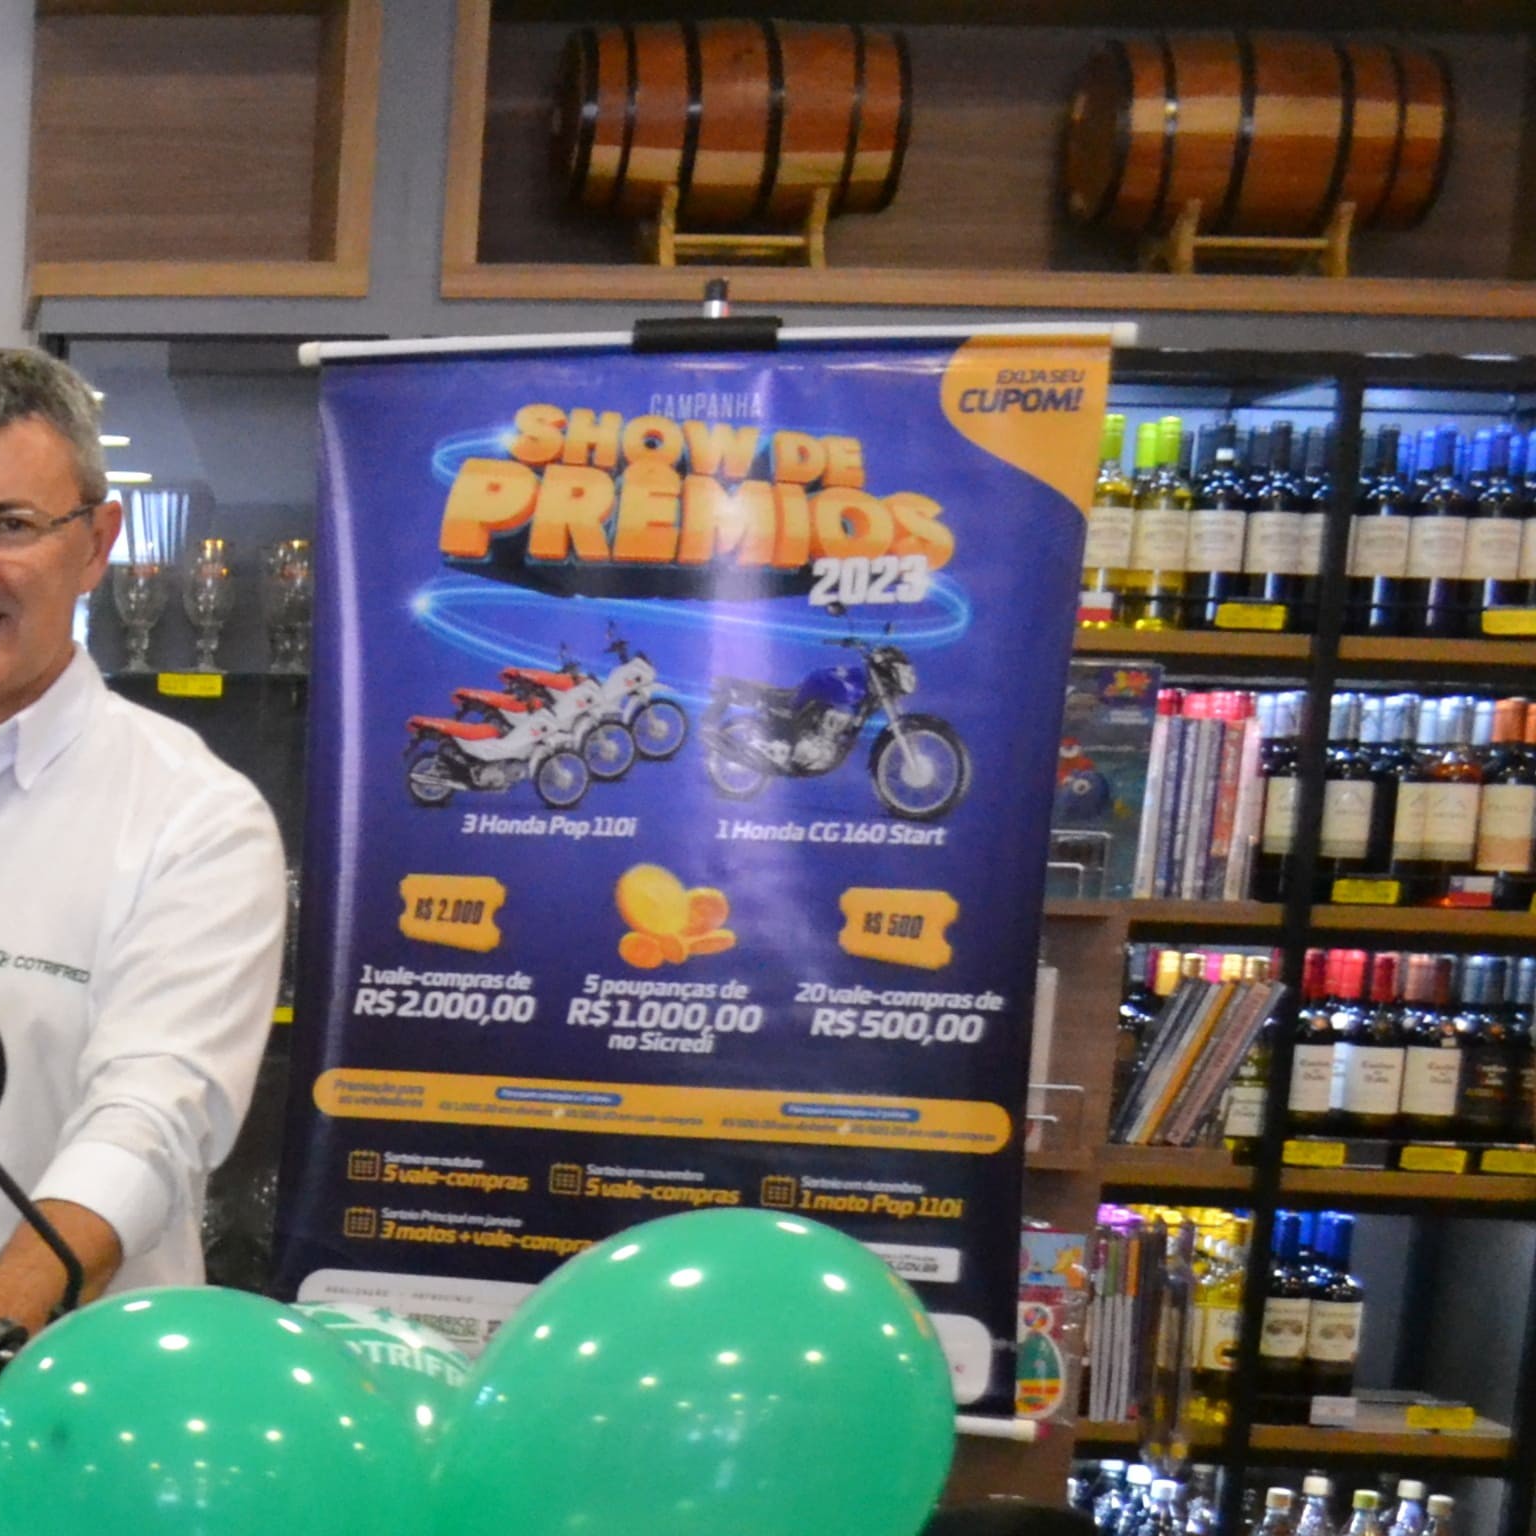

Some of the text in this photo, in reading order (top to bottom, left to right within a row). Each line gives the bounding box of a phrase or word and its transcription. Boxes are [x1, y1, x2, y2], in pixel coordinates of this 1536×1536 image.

[1049, 369, 1085, 383] SEU
[650, 392, 761, 418] CAMPANHA
[958, 388, 1083, 413] CUPOM!
[507, 404, 866, 490] SHOW DE
[808, 554, 928, 606] 2023
[461, 813, 636, 841] 3 Honda Pop 110i
[715, 820, 946, 846] 1 Honda CG 160 Start
[887, 914, 924, 939] 500
[14, 956, 91, 984] COTRIFRED
[360, 965, 532, 991] 1 vale-compras de
[585, 974, 749, 1000] 5 poupanças de
[794, 983, 1004, 1011] 20 vale-compras de
[608, 1031, 715, 1053] no Sicredi
[383, 1164, 529, 1192] 5 vale-compras
[585, 1177, 740, 1206] 5 vale-compras
[799, 1190, 963, 1219] 1 moto Pop 110i
[380, 1221, 396, 1239] 3
[396, 1224, 456, 1243] motos
[459, 1231, 472, 1243] +
